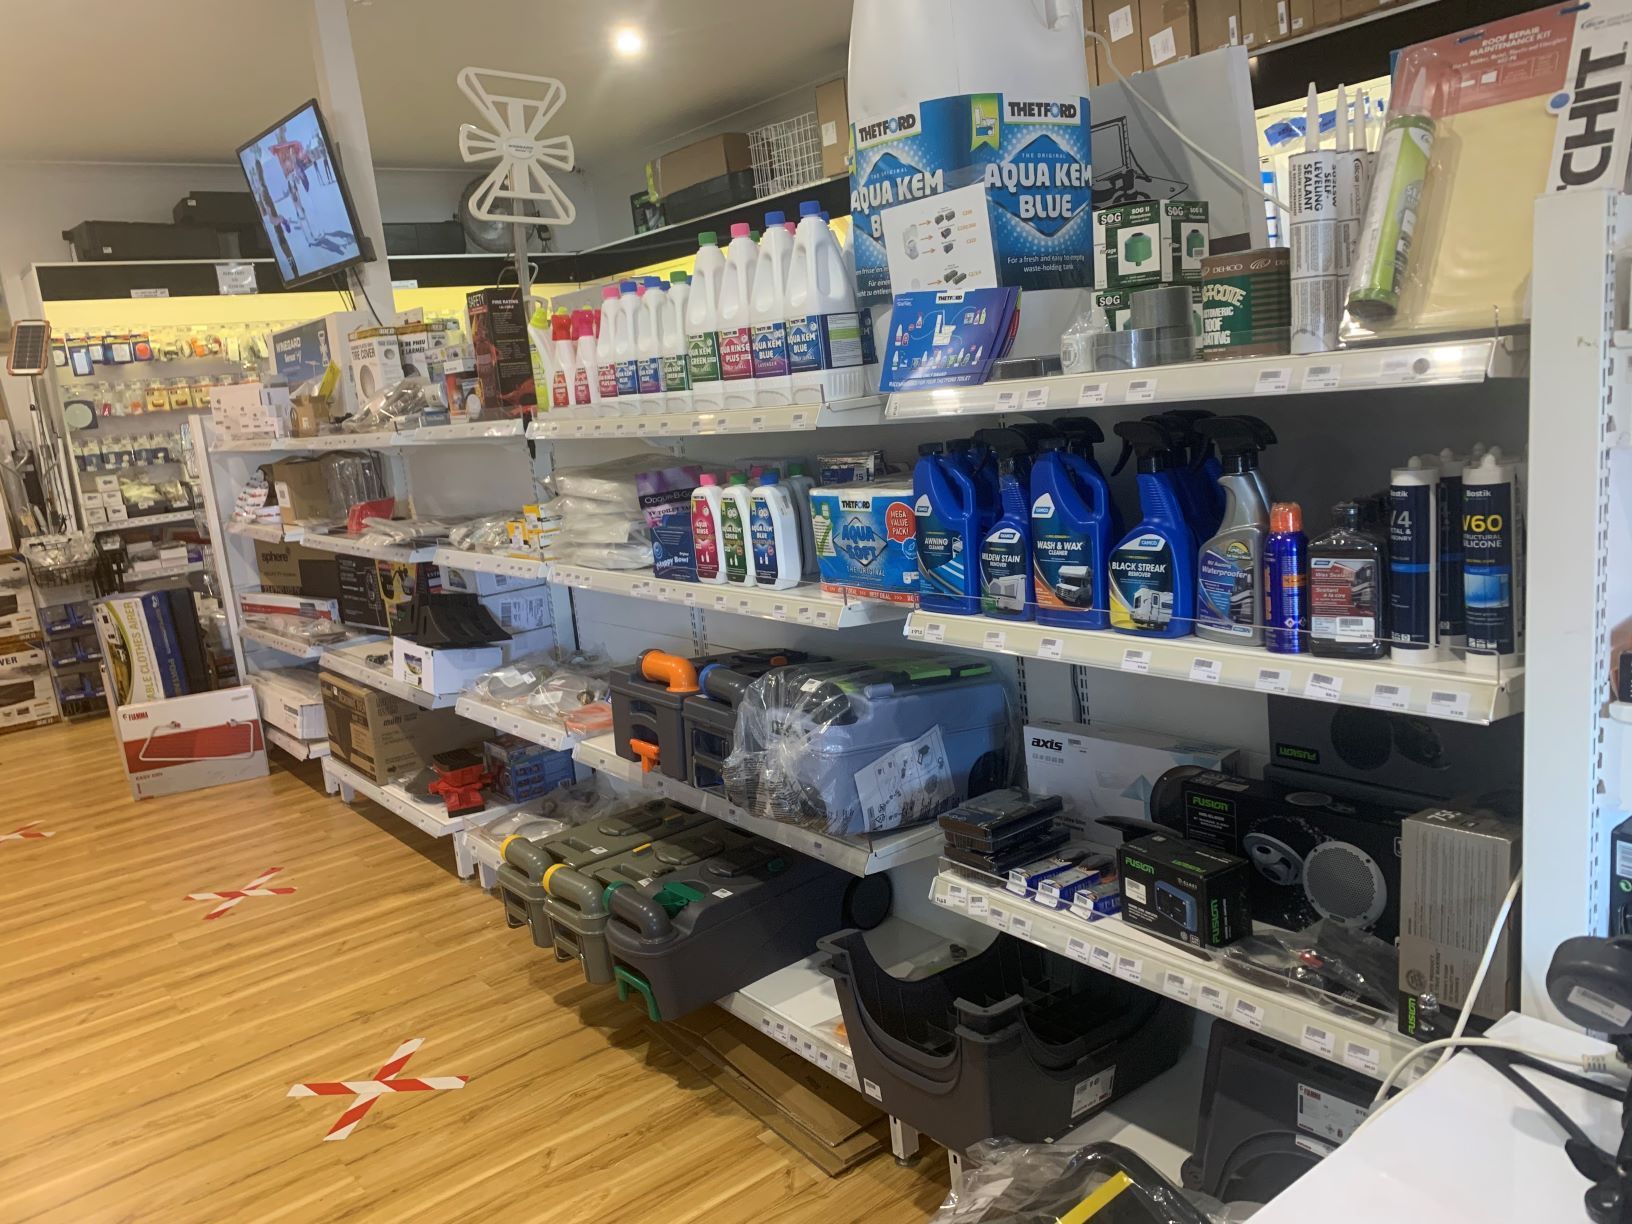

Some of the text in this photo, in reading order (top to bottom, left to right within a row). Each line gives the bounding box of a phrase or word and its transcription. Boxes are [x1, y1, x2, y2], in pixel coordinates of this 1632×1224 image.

[1482, 26, 1540, 47] ROOF REPAIR
[1469, 30, 1552, 57] MAINTENANCE KIT
[1008, 101, 1077, 119] THETFORD
[1556, 46, 1624, 191] CHIT
[858, 113, 917, 142] THETFORD
[984, 162, 1092, 193] AQUA KEM
[850, 168, 944, 215] AQUA KEM
[1304, 163, 1313, 211] SEALANT
[1314, 161, 1323, 212] LEVELING
[1019, 194, 1073, 219] BLUE
[1131, 207, 1144, 215] SOG
[1167, 206, 1184, 216] SOG
[1101, 212, 1122, 225] SOG
[1008, 256, 1018, 264] For
[1023, 255, 1039, 263] fresh
[1023, 263, 1062, 273] waste-holding
[1099, 295, 1121, 306] SOG
[767, 339, 782, 348] KEM
[801, 333, 817, 342] KEM
[360, 347, 375, 360] COVER
[731, 343, 751, 353] RINSE
[793, 343, 808, 354] BLUE
[725, 354, 740, 363] PLUS
[759, 350, 774, 360] BLUE
[1391, 489, 1409, 498] ostik
[1465, 488, 1492, 498] Bostik
[841, 500, 871, 509] THETFORD
[890, 510, 907, 518] MEGA
[890, 519, 909, 527] VALUE
[841, 524, 876, 545] AQUA
[892, 527, 909, 536] PACK!
[924, 538, 949, 546] AWNING
[1037, 540, 1083, 551] WASH & WAX
[982, 552, 1021, 563] MILDEW STAIN
[656, 558, 674, 571] Happy
[1111, 561, 1166, 573] BLACK STREAK
[859, 567, 886, 577] ORIGINAL
[1201, 565, 1248, 579] Waterproofer
[123, 601, 138, 631] AIRER
[132, 631, 150, 674] CLOTHES
[128, 711, 148, 721] FIAMMA
[1031, 737, 1063, 751] axis
[1279, 746, 1317, 761] FUSION
[1192, 796, 1229, 811] FUSION
[1125, 856, 1155, 875] FUSION
[1210, 899, 1220, 945] FUSION
[1407, 996, 1418, 1035] FUSION
